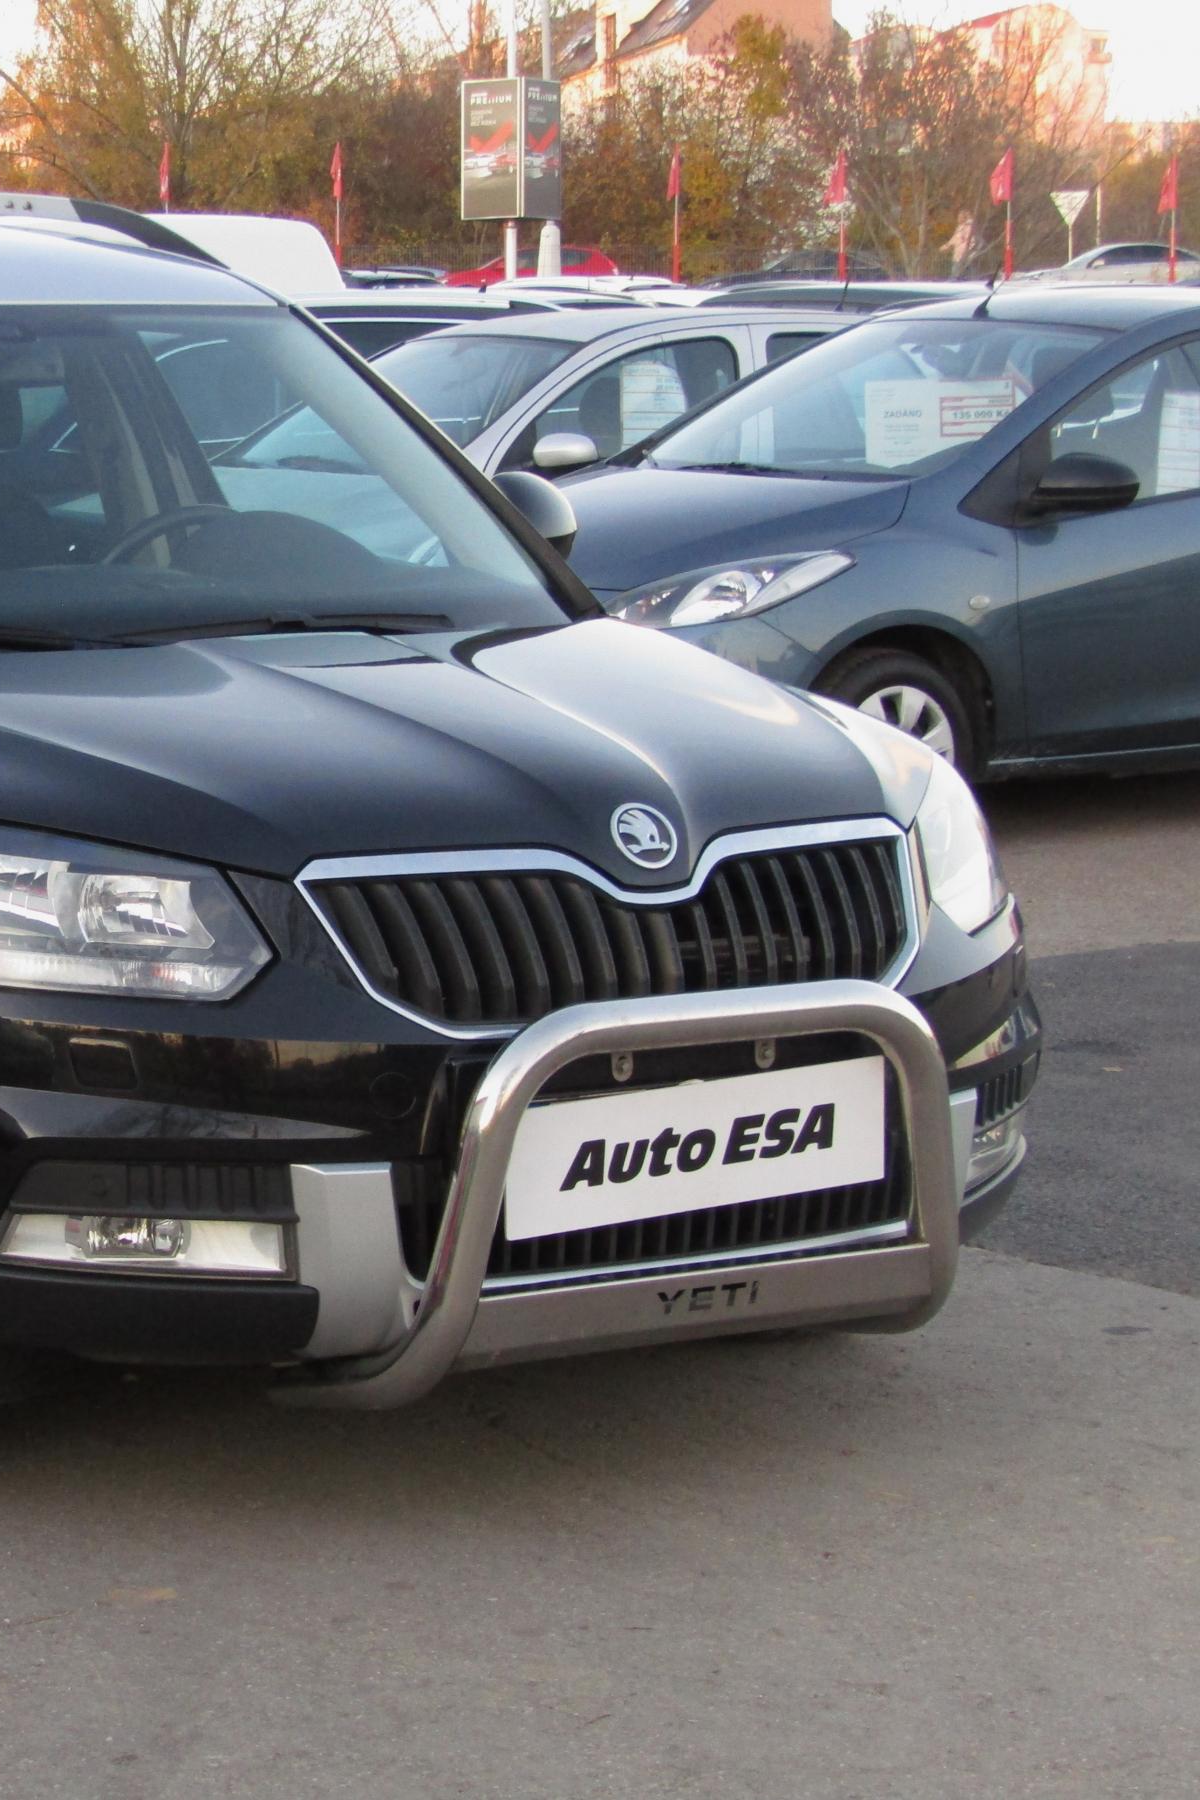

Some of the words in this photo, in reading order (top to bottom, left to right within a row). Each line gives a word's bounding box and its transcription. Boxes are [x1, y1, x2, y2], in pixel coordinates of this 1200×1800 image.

[559, 1127, 716, 1192] Auto
[722, 1102, 835, 1165] ESA
[657, 1280, 760, 1315] YETI
